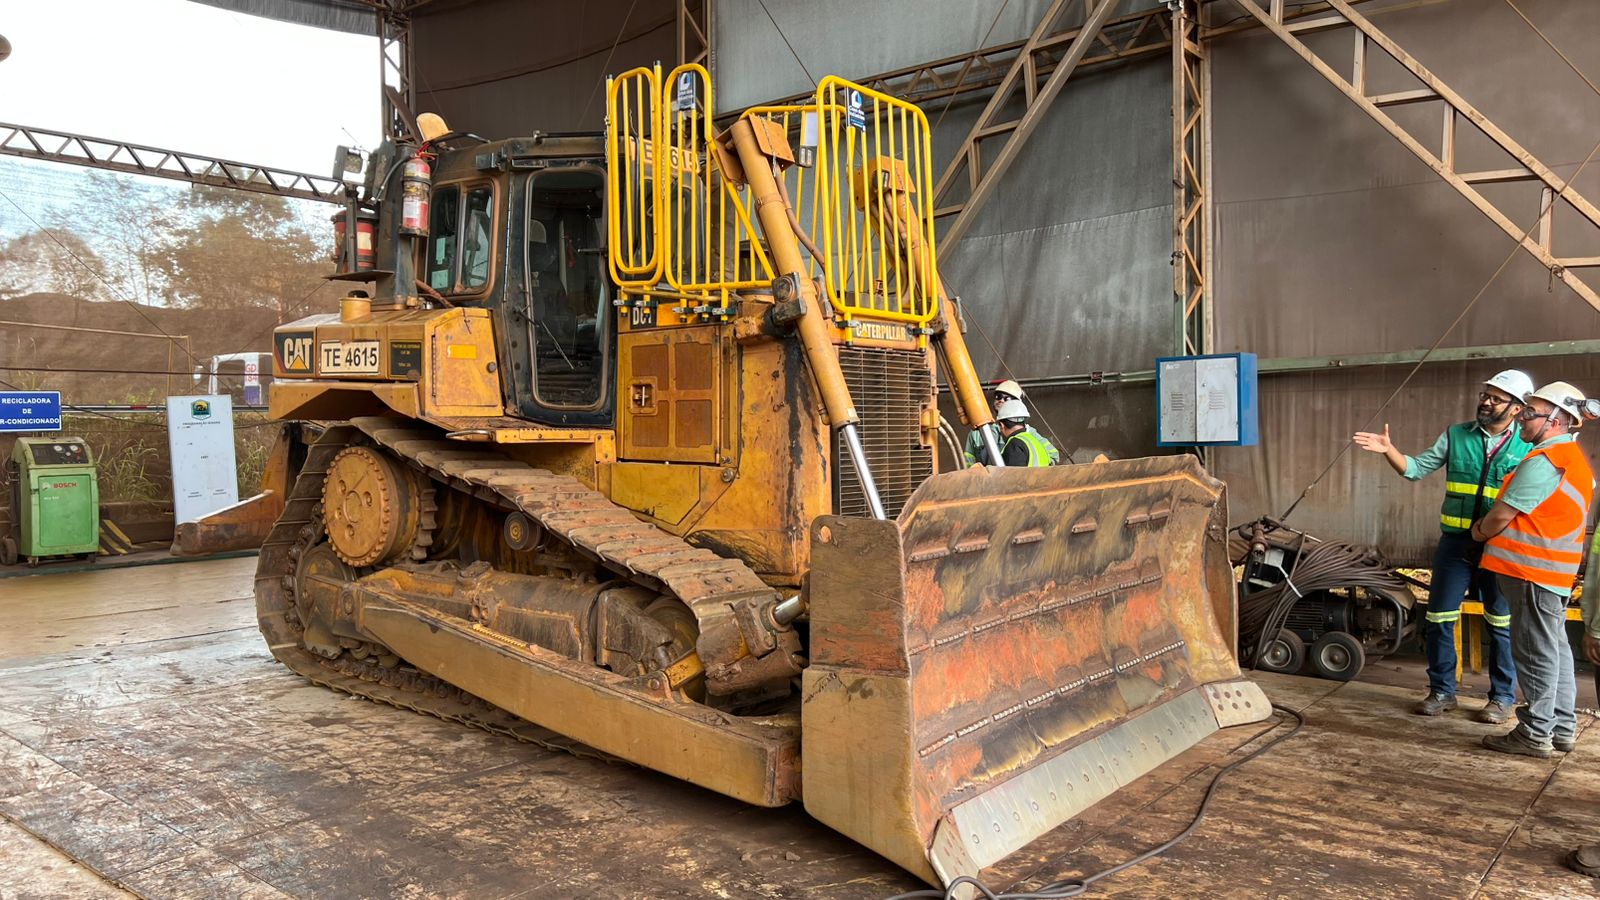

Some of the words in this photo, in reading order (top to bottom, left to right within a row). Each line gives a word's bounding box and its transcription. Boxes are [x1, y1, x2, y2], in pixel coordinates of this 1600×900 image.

[856, 321, 906, 340] CATERPILLAR
[284, 338, 313, 370] CAT
[324, 348, 341, 367] TE
[345, 347, 378, 367] 4615
[2, 397, 52, 405] RECICLADORA
[22, 407, 32, 415] DE
[53, 481, 78, 489] BOSCH
